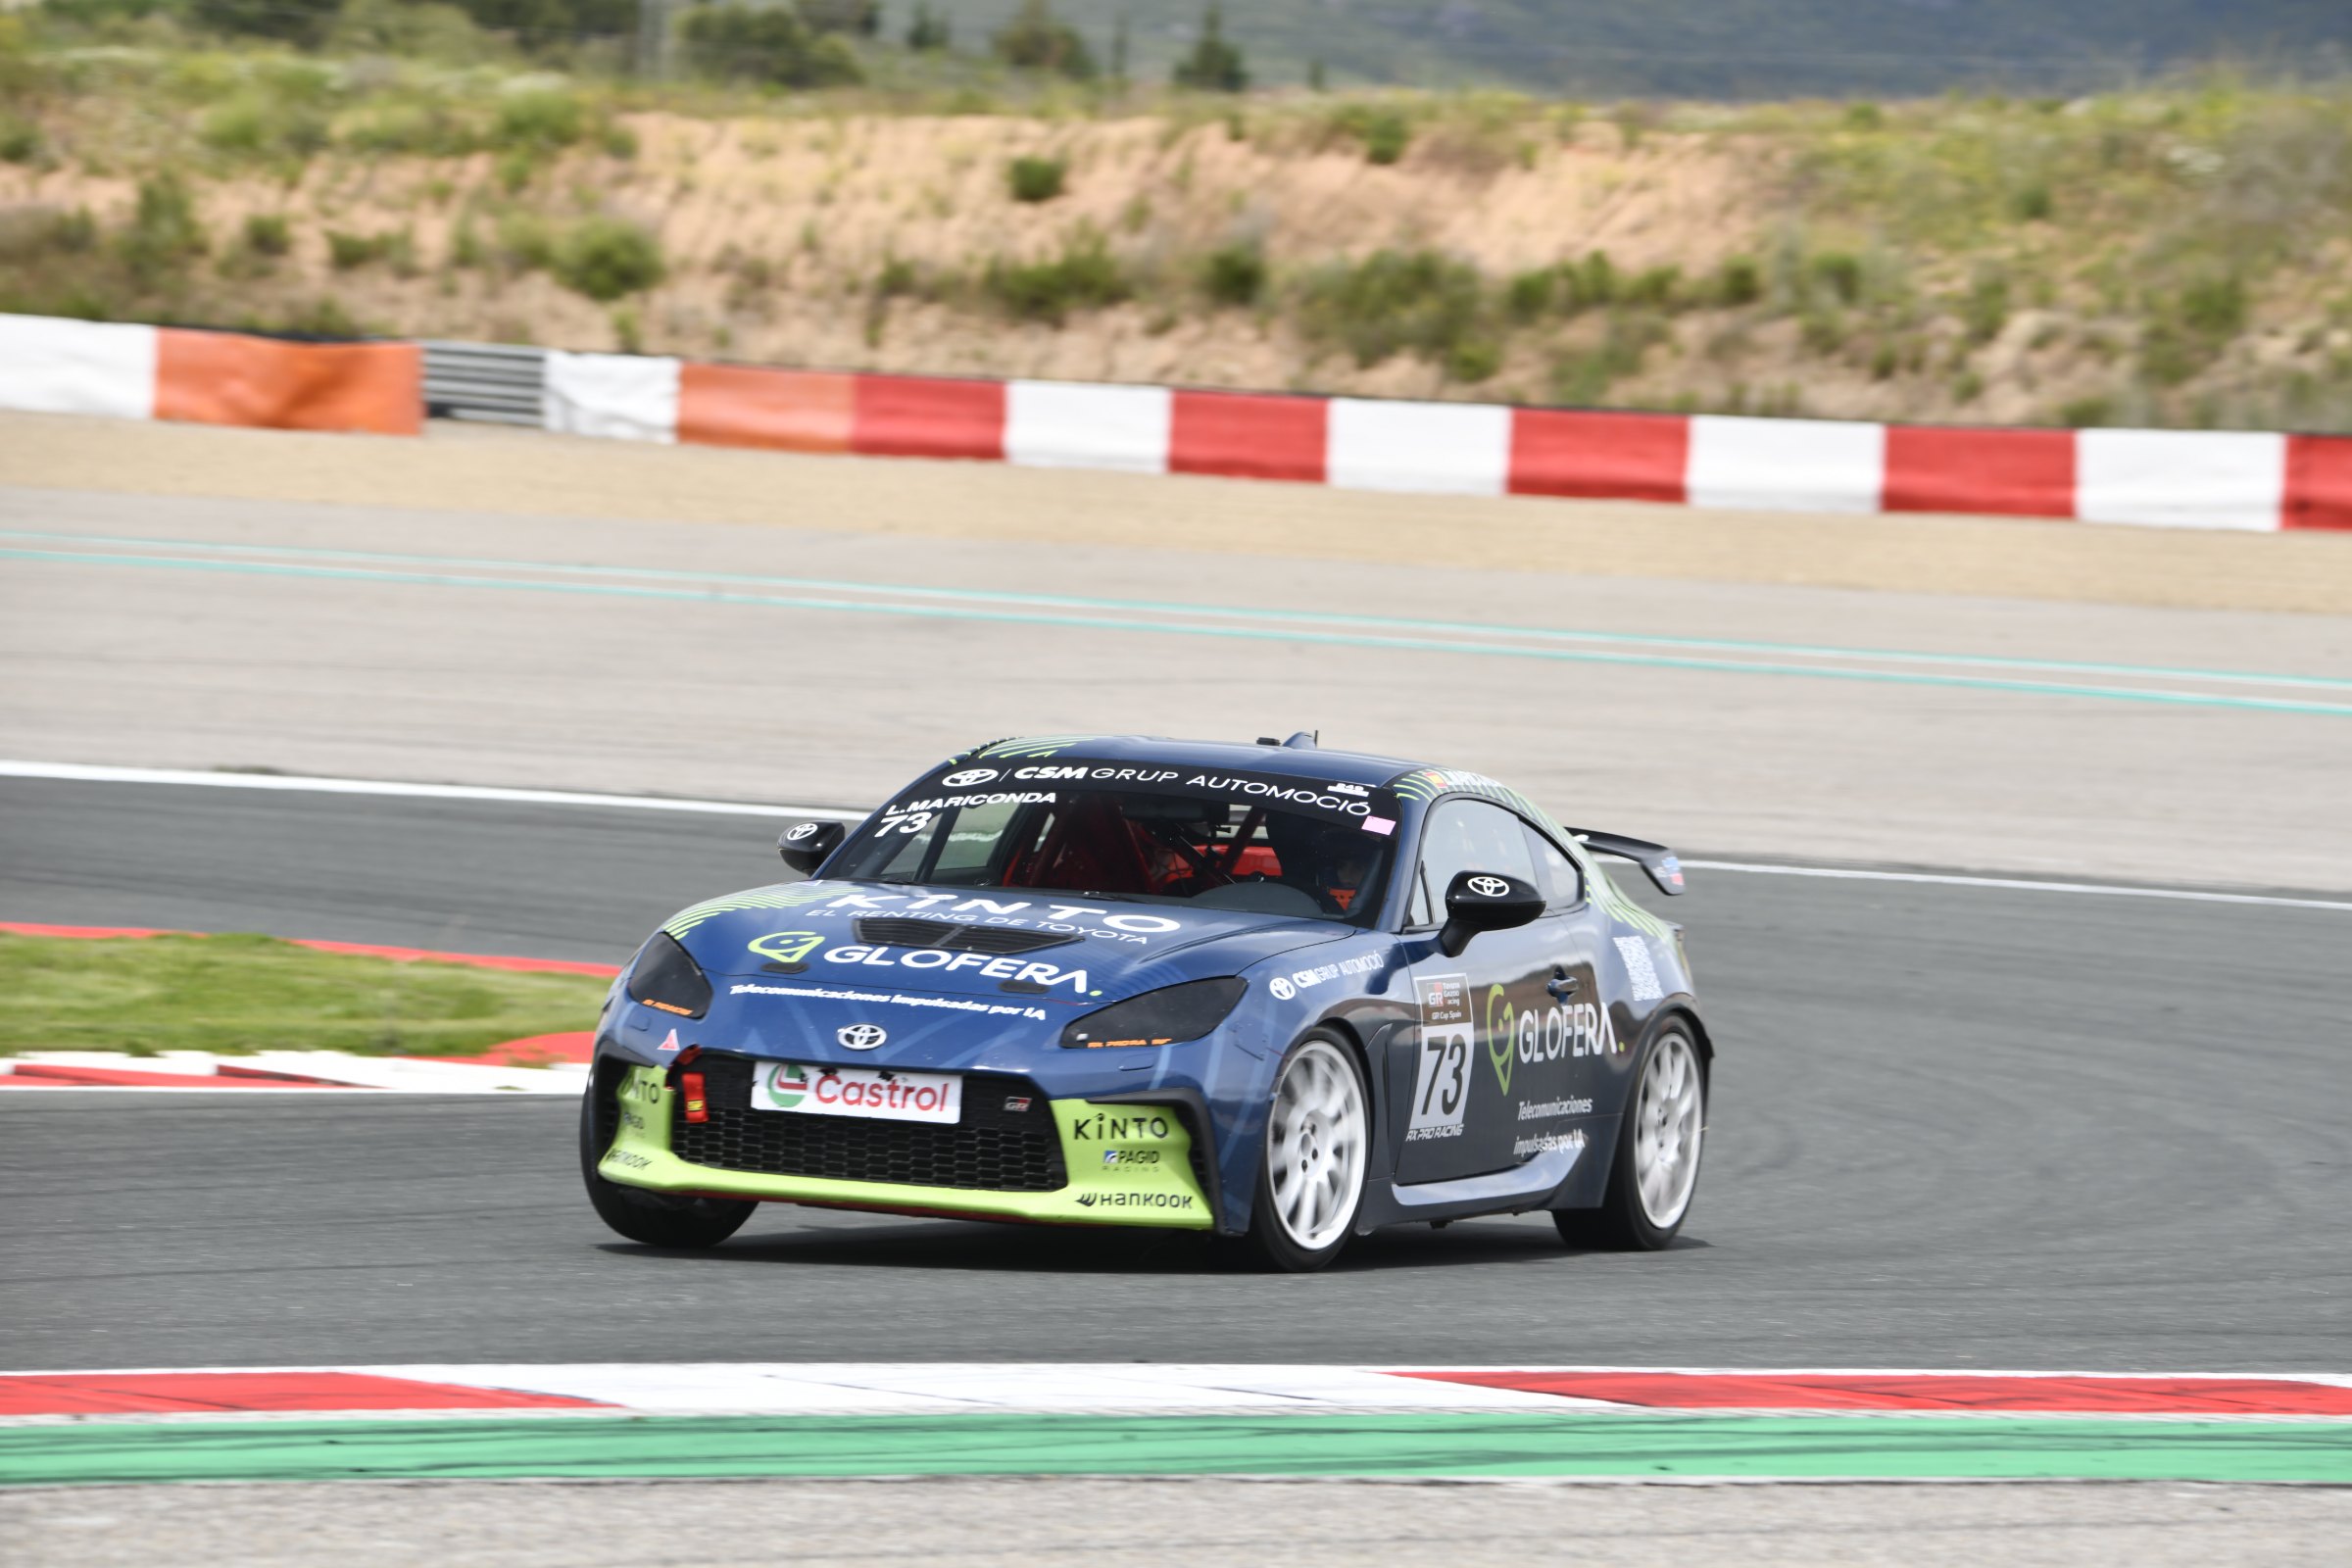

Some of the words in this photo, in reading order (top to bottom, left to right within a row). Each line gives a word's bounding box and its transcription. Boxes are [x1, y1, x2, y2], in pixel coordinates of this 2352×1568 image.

[885, 792, 1056, 816] L.MARICONDA
[1014, 766, 1089, 780] CSM
[1090, 767, 1179, 783] GRUP
[1186, 774, 1371, 816] AUTOMOCIÓ
[874, 811, 933, 838] 73
[806, 908, 837, 917] EL
[847, 909, 979, 922] RENTING
[985, 915, 1029, 928] DE
[1037, 921, 1149, 946] TOYOTA
[1314, 963, 1341, 982] GRUP
[729, 983, 891, 1004] Telecomunicaciones
[987, 1005, 1025, 1015] por
[1428, 992, 1444, 1005] GR
[1421, 1033, 1467, 1115] 73
[815, 1074, 949, 1112] Castrol
[1517, 1095, 1593, 1121] Telecomunicaciones
[1434, 1123, 1465, 1138] RACING
[1118, 1150, 1160, 1165] PAGID
[1513, 1131, 1559, 1158] impulsadas
[1557, 1133, 1575, 1154] por
